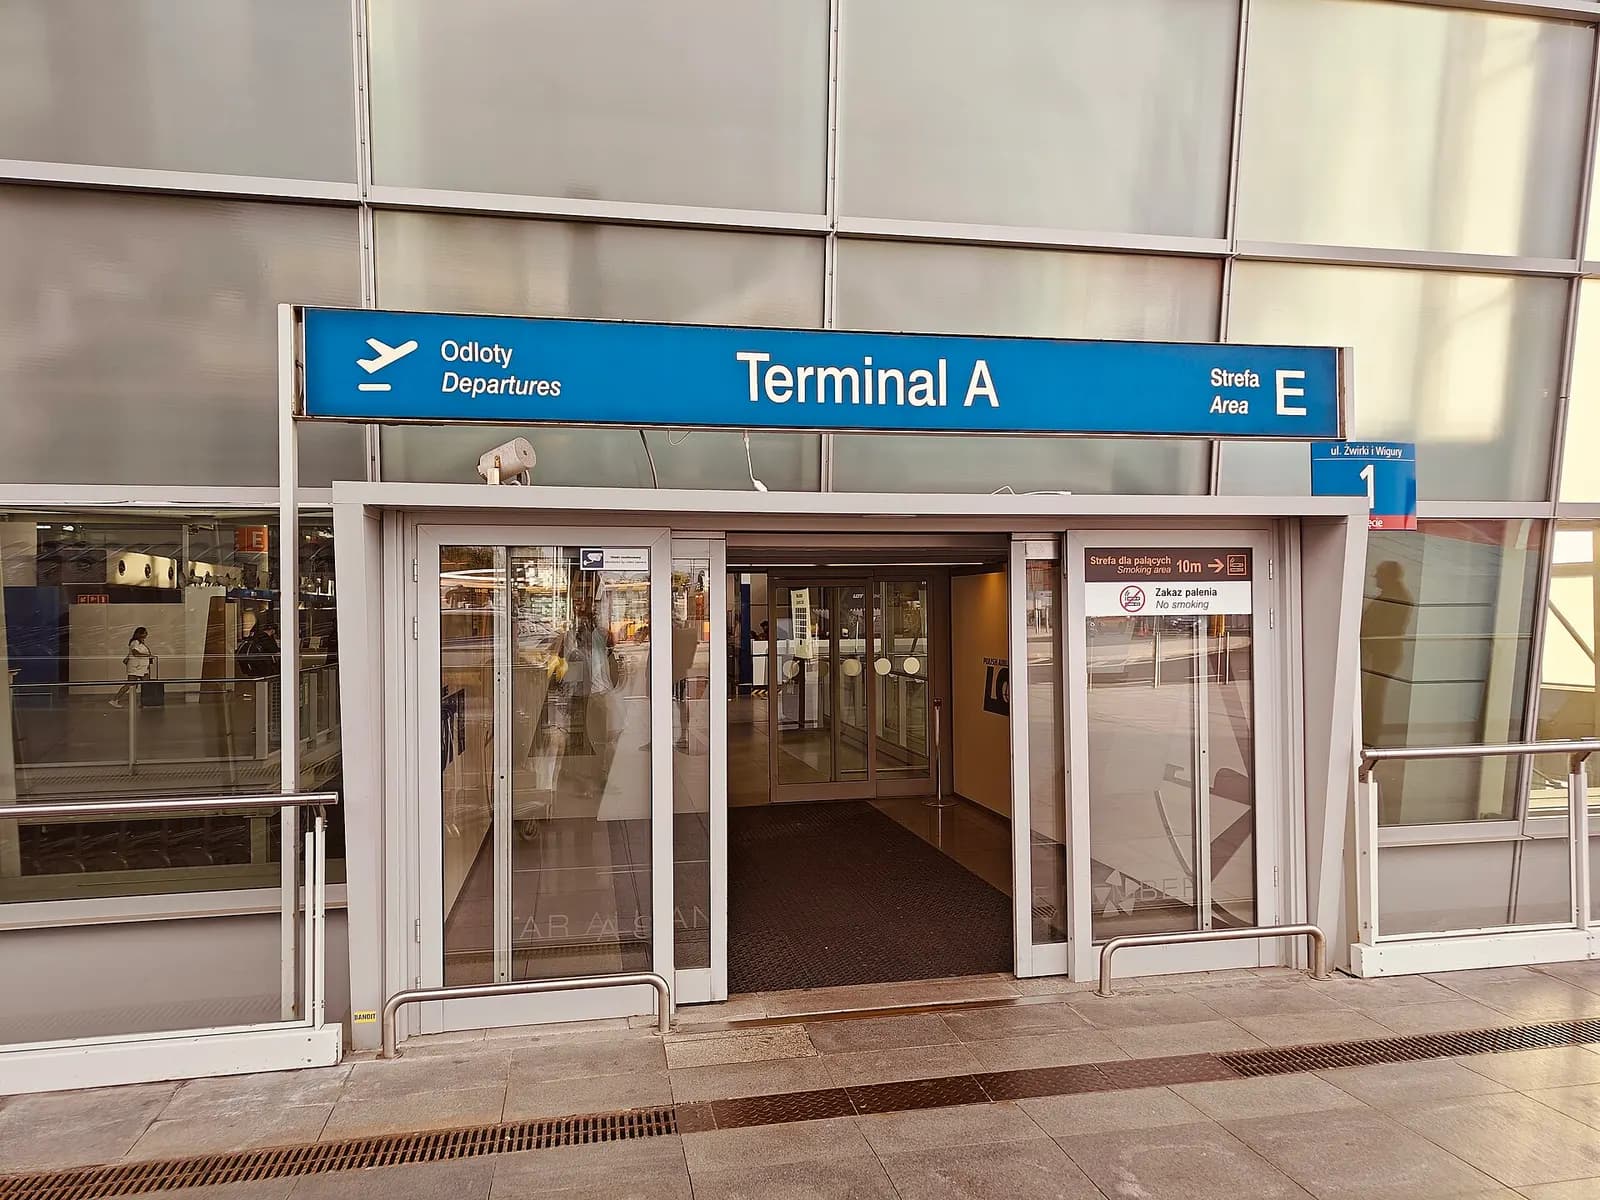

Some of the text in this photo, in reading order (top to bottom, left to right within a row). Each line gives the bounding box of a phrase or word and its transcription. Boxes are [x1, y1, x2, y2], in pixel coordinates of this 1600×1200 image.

[440, 339, 513, 369] Odloty
[441, 371, 562, 399] Departures
[735, 350, 1001, 408] Terminal A
[1210, 367, 1260, 388] Strefa
[1275, 369, 1307, 416] E
[1209, 395, 1249, 415] Area
[1330, 445, 1342, 456] ul.
[1375, 446, 1402, 458] Wigury
[1359, 464, 1375, 509] 1
[1089, 555, 1172, 568] Strefa dla palących
[1117, 565, 1172, 576] Smoking area
[1176, 559, 1202, 574] 10m
[1155, 587, 1218, 599] Zakaz palenia
[1155, 600, 1210, 611] No smoking
